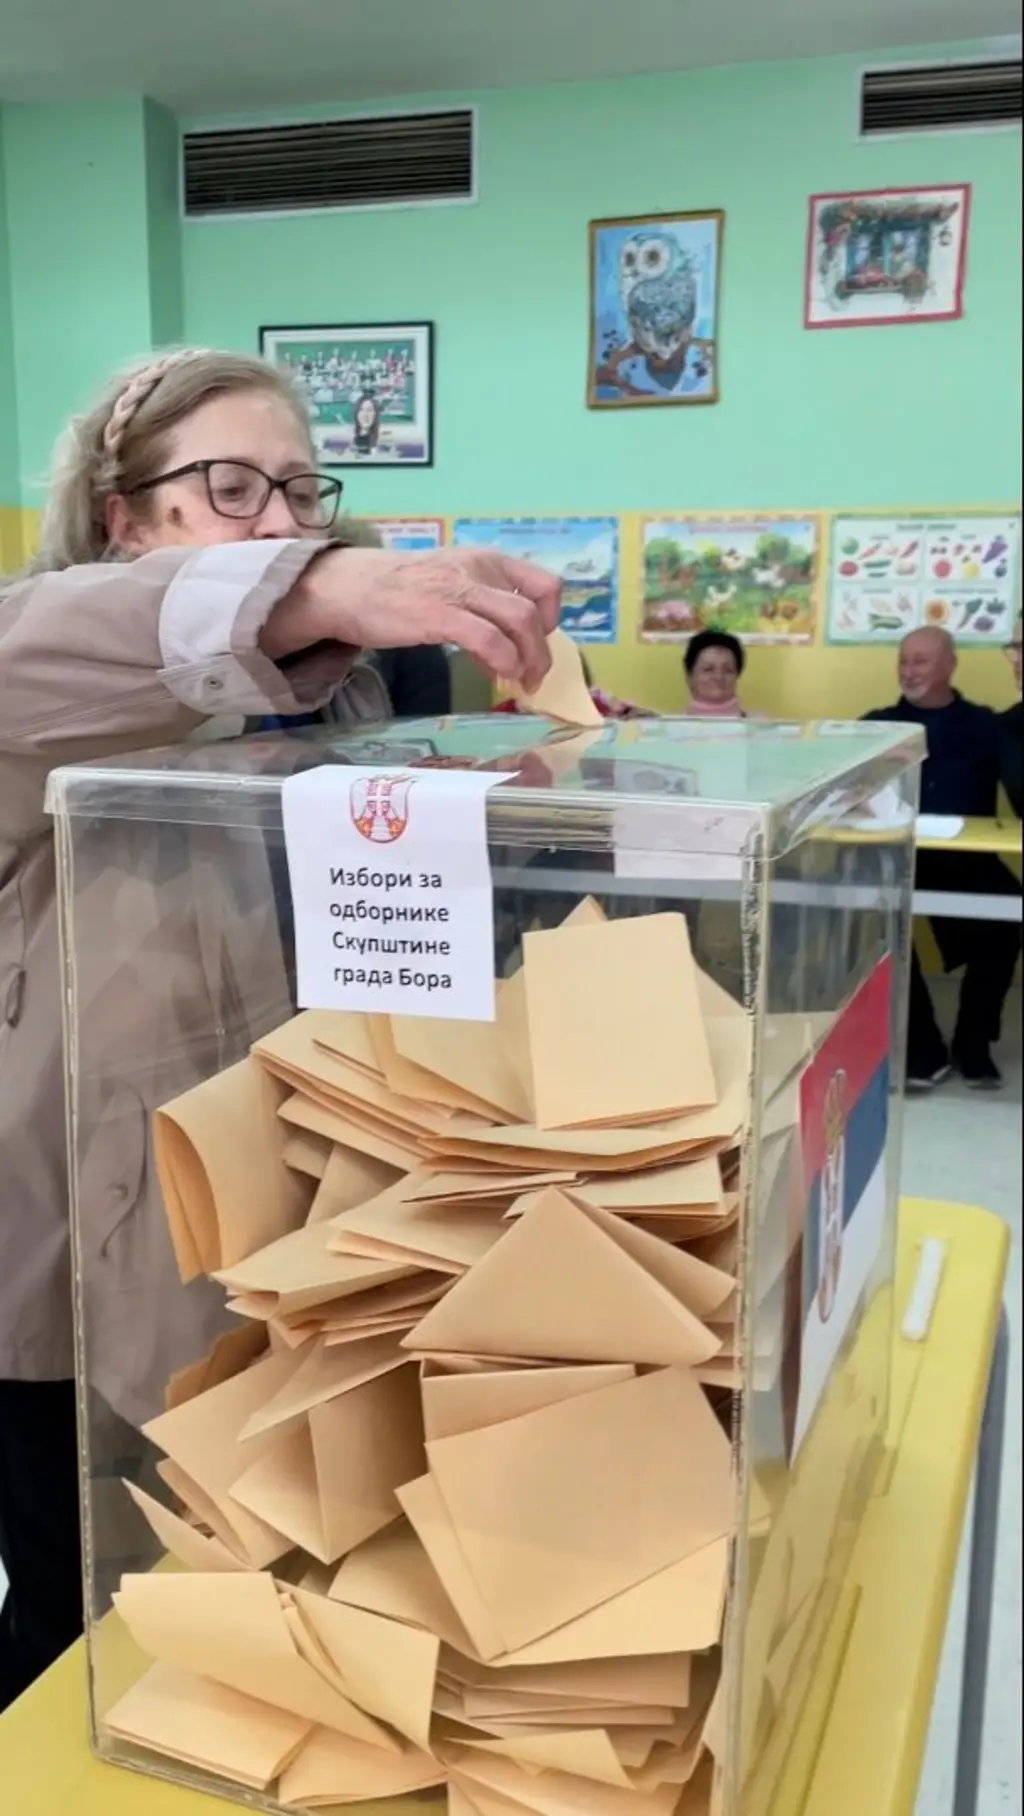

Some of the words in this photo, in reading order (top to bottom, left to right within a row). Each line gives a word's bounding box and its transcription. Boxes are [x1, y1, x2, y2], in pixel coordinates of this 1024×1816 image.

[329, 867, 412, 891] Избори
[418, 872, 442, 889] за
[329, 900, 450, 925] одборнике
[332, 931, 451, 956] Скупштине
[333, 966, 393, 988] града
[398, 968, 453, 992] Бора
